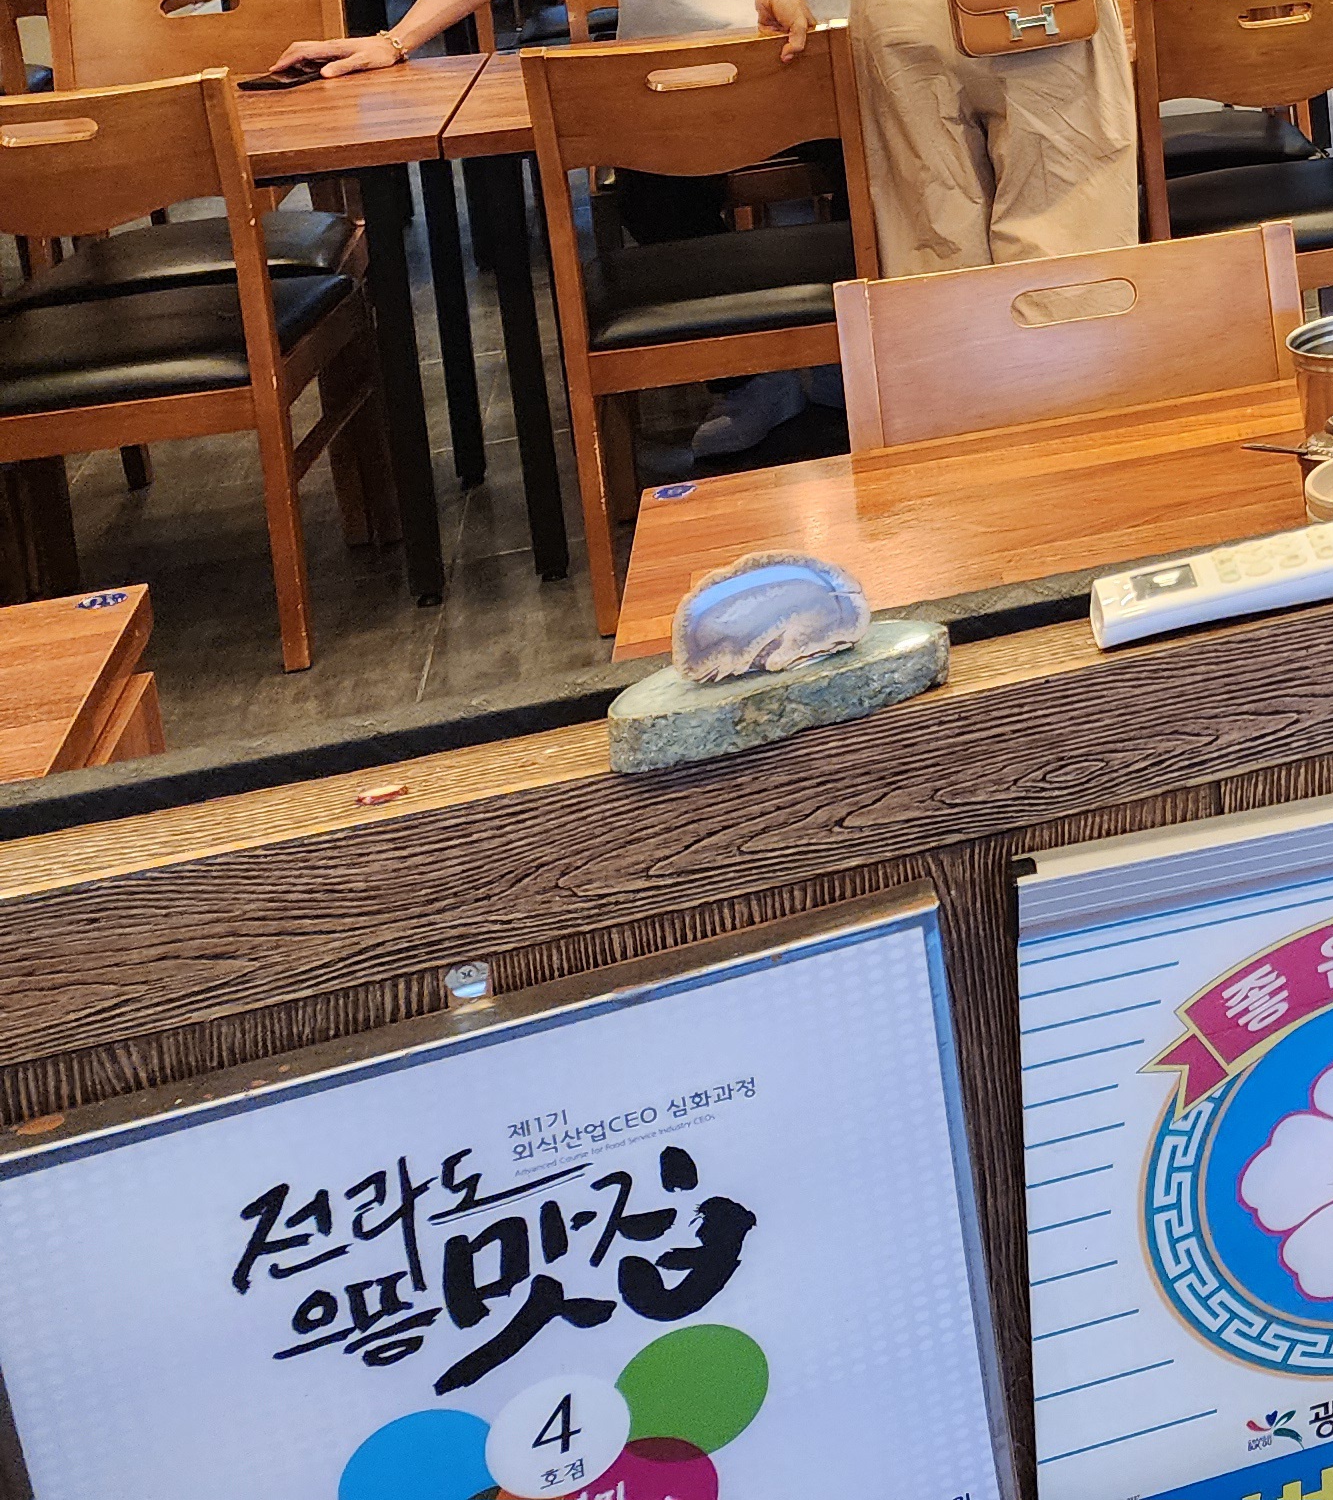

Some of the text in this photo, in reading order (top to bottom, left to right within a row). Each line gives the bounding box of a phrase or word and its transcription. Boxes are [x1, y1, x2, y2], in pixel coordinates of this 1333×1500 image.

[508, 1109, 568, 1139] 제1기
[512, 1077, 757, 1162] 외식산업CEO 심화과정
[628, 1132, 657, 1144] Service
[657, 1119, 692, 1136] Industry
[231, 1148, 593, 1295] 전라도
[433, 1146, 757, 1396] 맛집
[531, 1392, 582, 1455] 4
[538, 1457, 586, 1491] 호점
